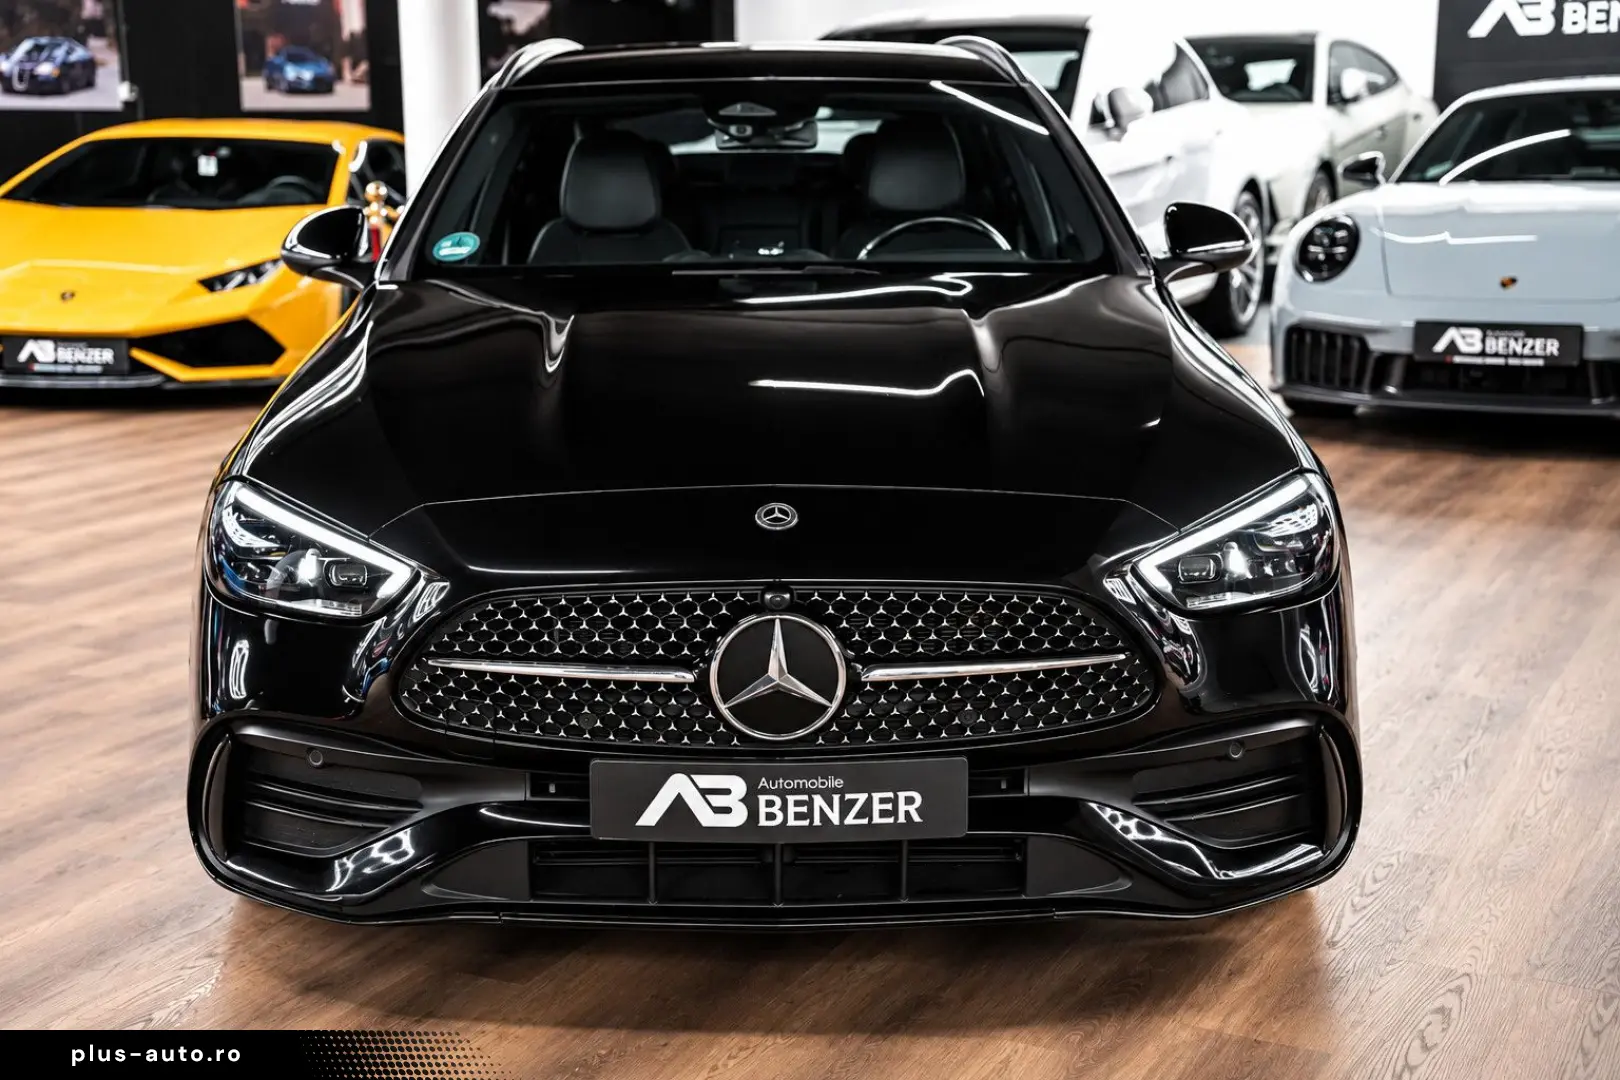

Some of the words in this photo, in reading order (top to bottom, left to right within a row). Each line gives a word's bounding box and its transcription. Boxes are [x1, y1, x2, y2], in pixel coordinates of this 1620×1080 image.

[1485, 337, 1560, 356] BENZER
[758, 776, 844, 790] Automobile
[635, 773, 748, 827] AB
[757, 791, 923, 827] BENZER
